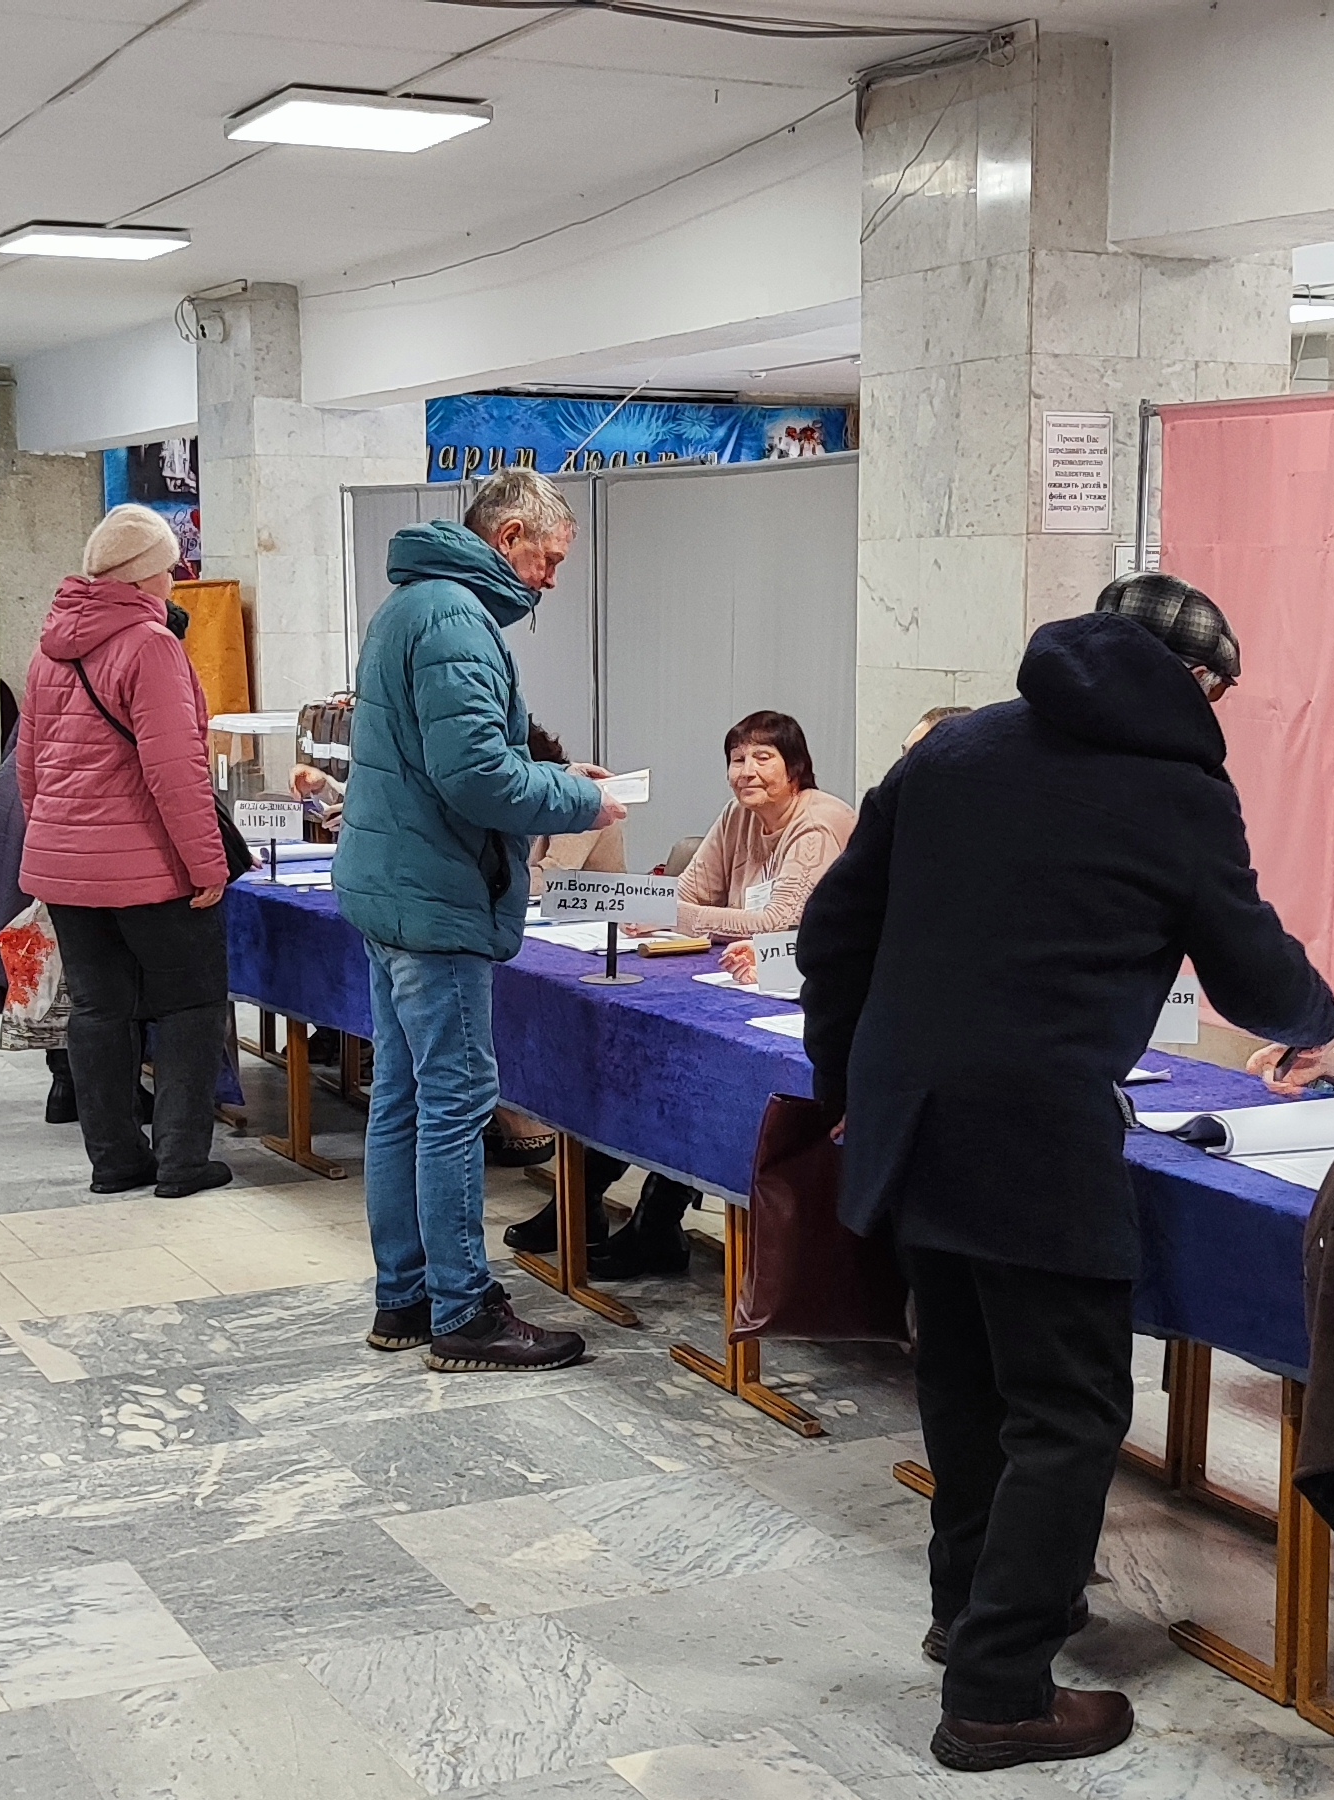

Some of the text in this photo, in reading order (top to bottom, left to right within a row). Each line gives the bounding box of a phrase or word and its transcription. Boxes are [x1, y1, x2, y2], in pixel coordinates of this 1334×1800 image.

[427, 445, 537, 481] арим
[546, 879, 675, 898] ул.Волго-Донская
[557, 897, 625, 912] д.23 д.25
